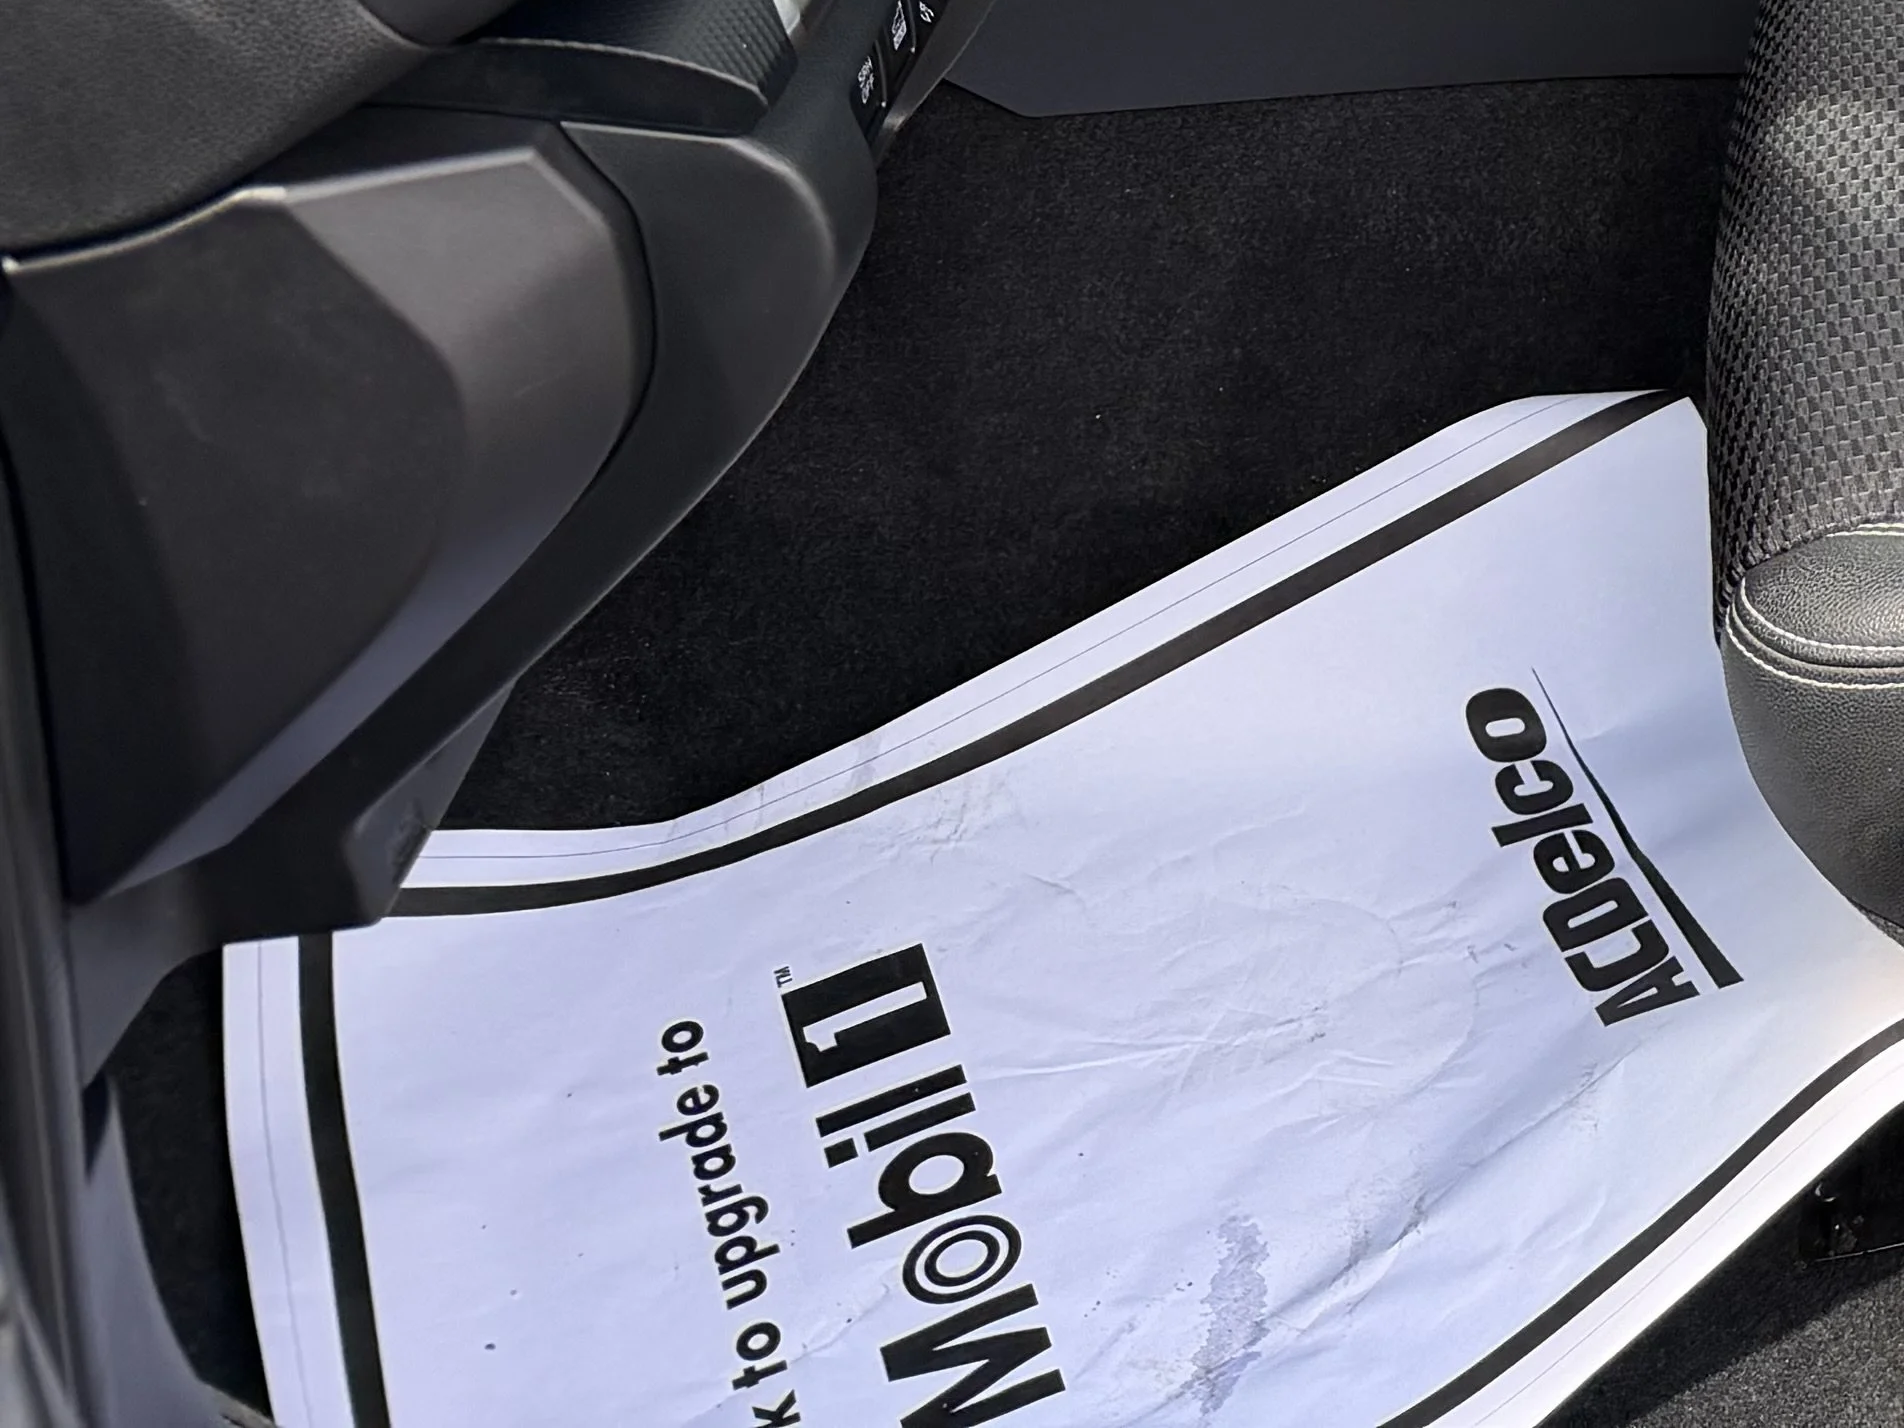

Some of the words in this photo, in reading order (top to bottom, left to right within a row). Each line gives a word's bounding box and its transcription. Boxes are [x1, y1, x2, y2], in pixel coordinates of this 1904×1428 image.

[1465, 687, 1701, 1027] ACDelco
[656, 1020, 709, 1076] to
[658, 1083, 781, 1311] upgrade
[815, 1063, 1066, 1428] Mobil
[731, 1321, 788, 1391] to
